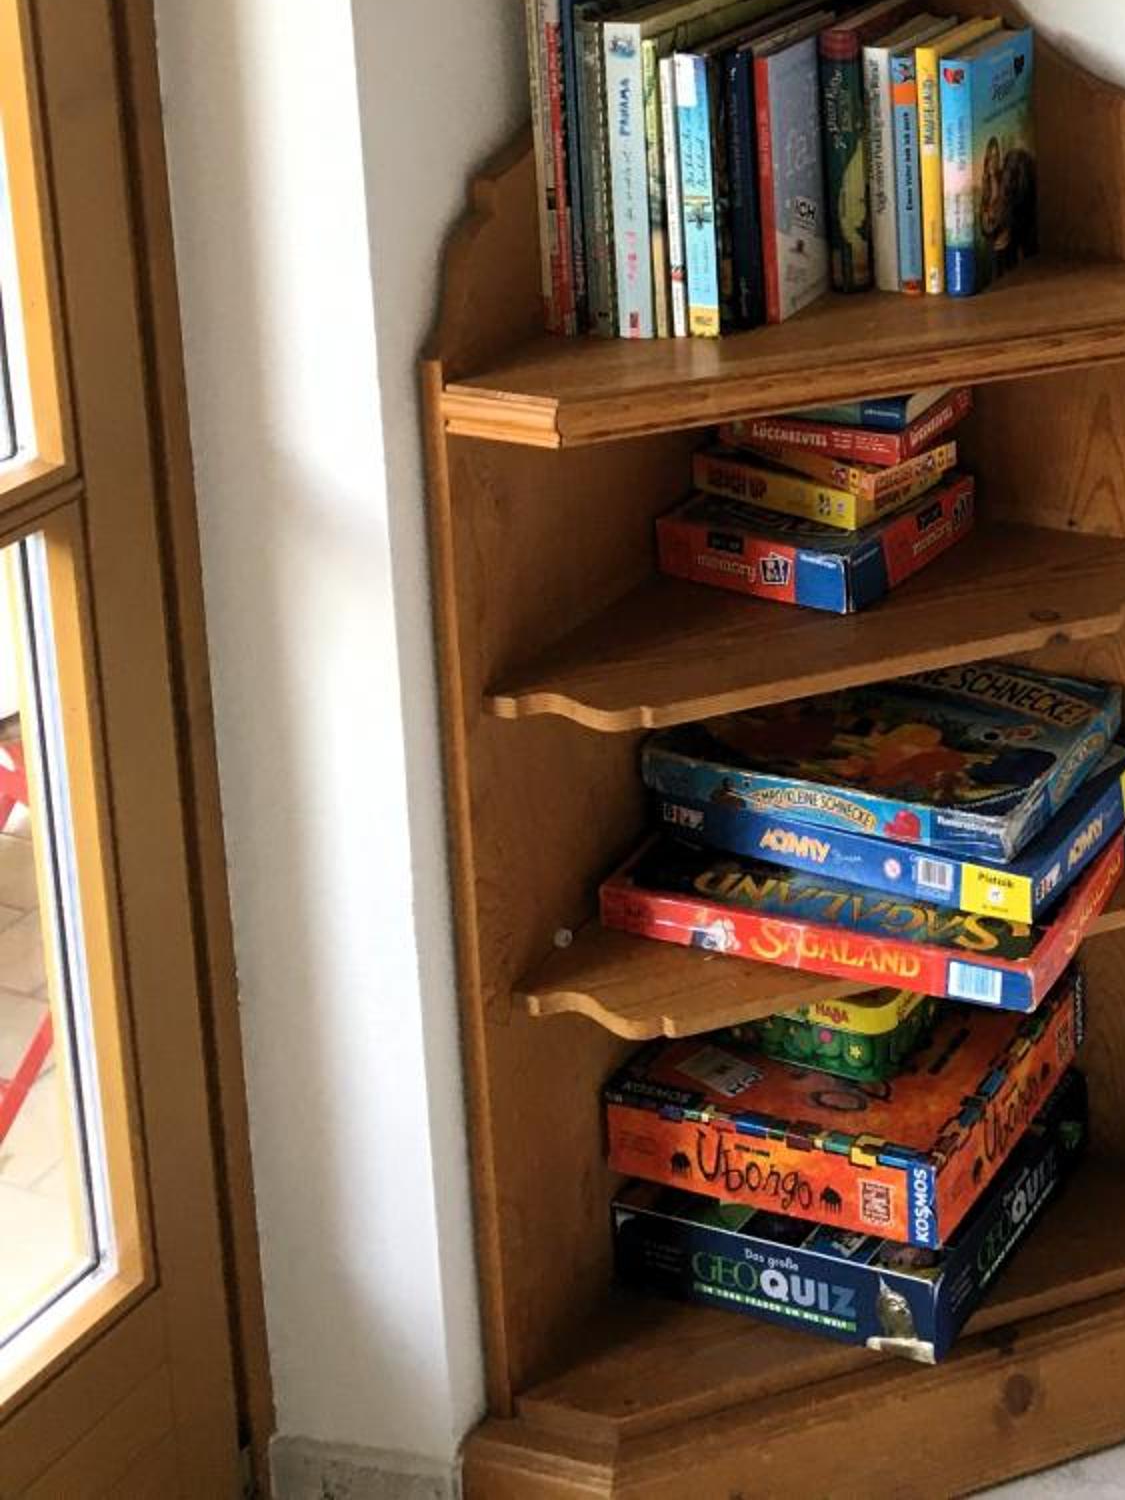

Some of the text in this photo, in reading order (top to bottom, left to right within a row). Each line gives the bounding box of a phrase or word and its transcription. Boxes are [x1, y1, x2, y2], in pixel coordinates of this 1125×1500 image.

[619, 77, 631, 137] PANAMA
[760, 827, 831, 863] ACTIVITY
[692, 868, 1031, 951] SAGALAND
[751, 922, 921, 979] SAGALAND
[815, 1004, 849, 1025] HABA
[697, 1128, 812, 1211] Ubongo
[913, 1169, 928, 1244] KOSMOS
[744, 1247, 765, 1263] Das
